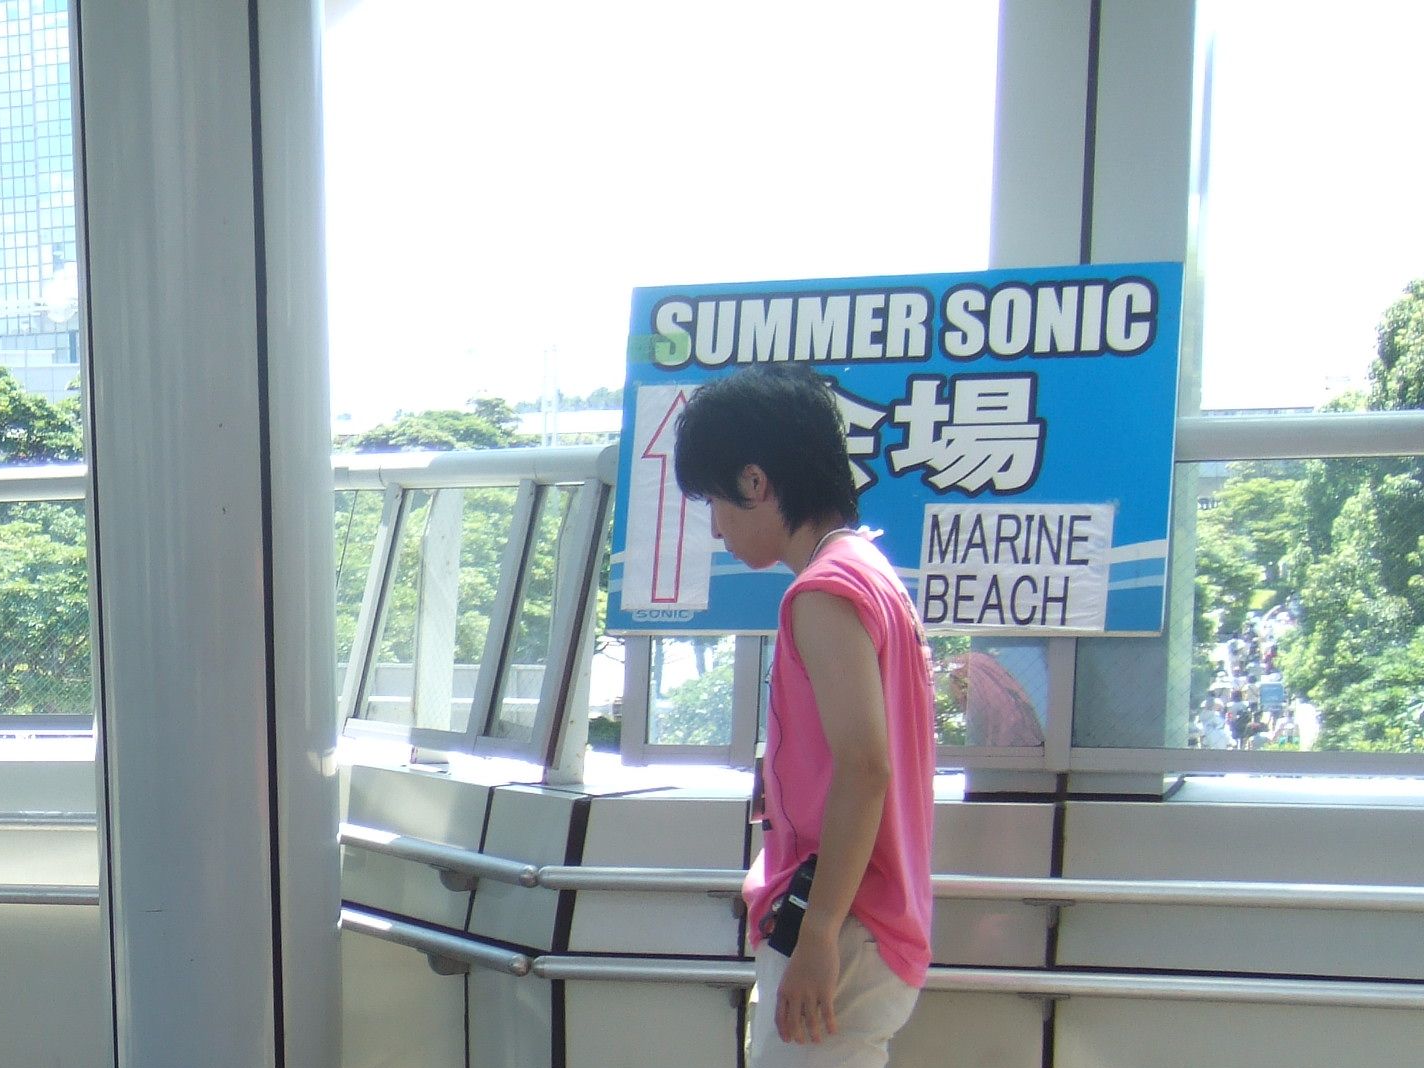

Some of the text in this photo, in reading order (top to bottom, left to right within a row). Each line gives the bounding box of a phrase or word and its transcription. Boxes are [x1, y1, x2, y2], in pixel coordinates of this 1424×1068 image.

[653, 281, 1156, 366] SUMMER SONIC
[927, 512, 1092, 566] MARINE
[923, 573, 1070, 627] BEACH
